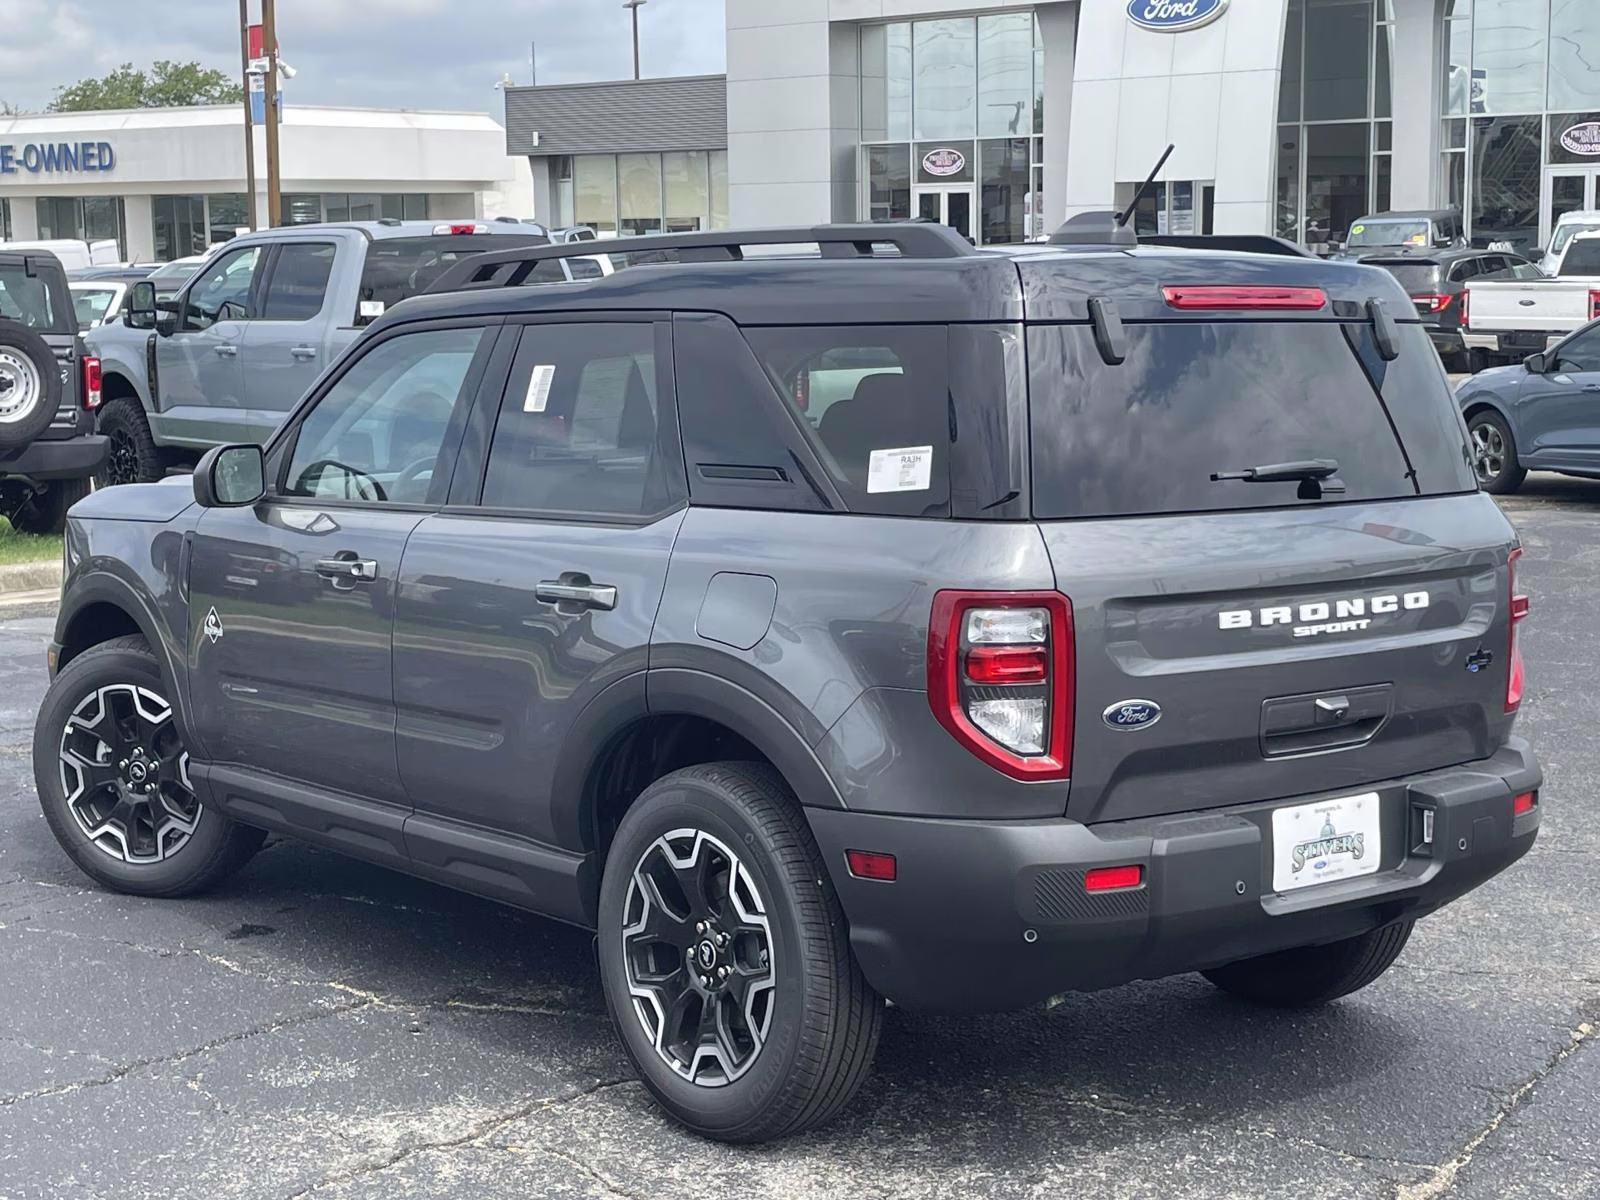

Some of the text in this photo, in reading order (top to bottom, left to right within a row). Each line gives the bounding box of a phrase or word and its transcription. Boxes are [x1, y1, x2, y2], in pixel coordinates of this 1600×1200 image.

[1218, 591, 1430, 630] BRONCO
[1292, 618, 1372, 637] SPORT
[1117, 705, 1150, 723] Ford
[1291, 832, 1364, 874] STIVERS
